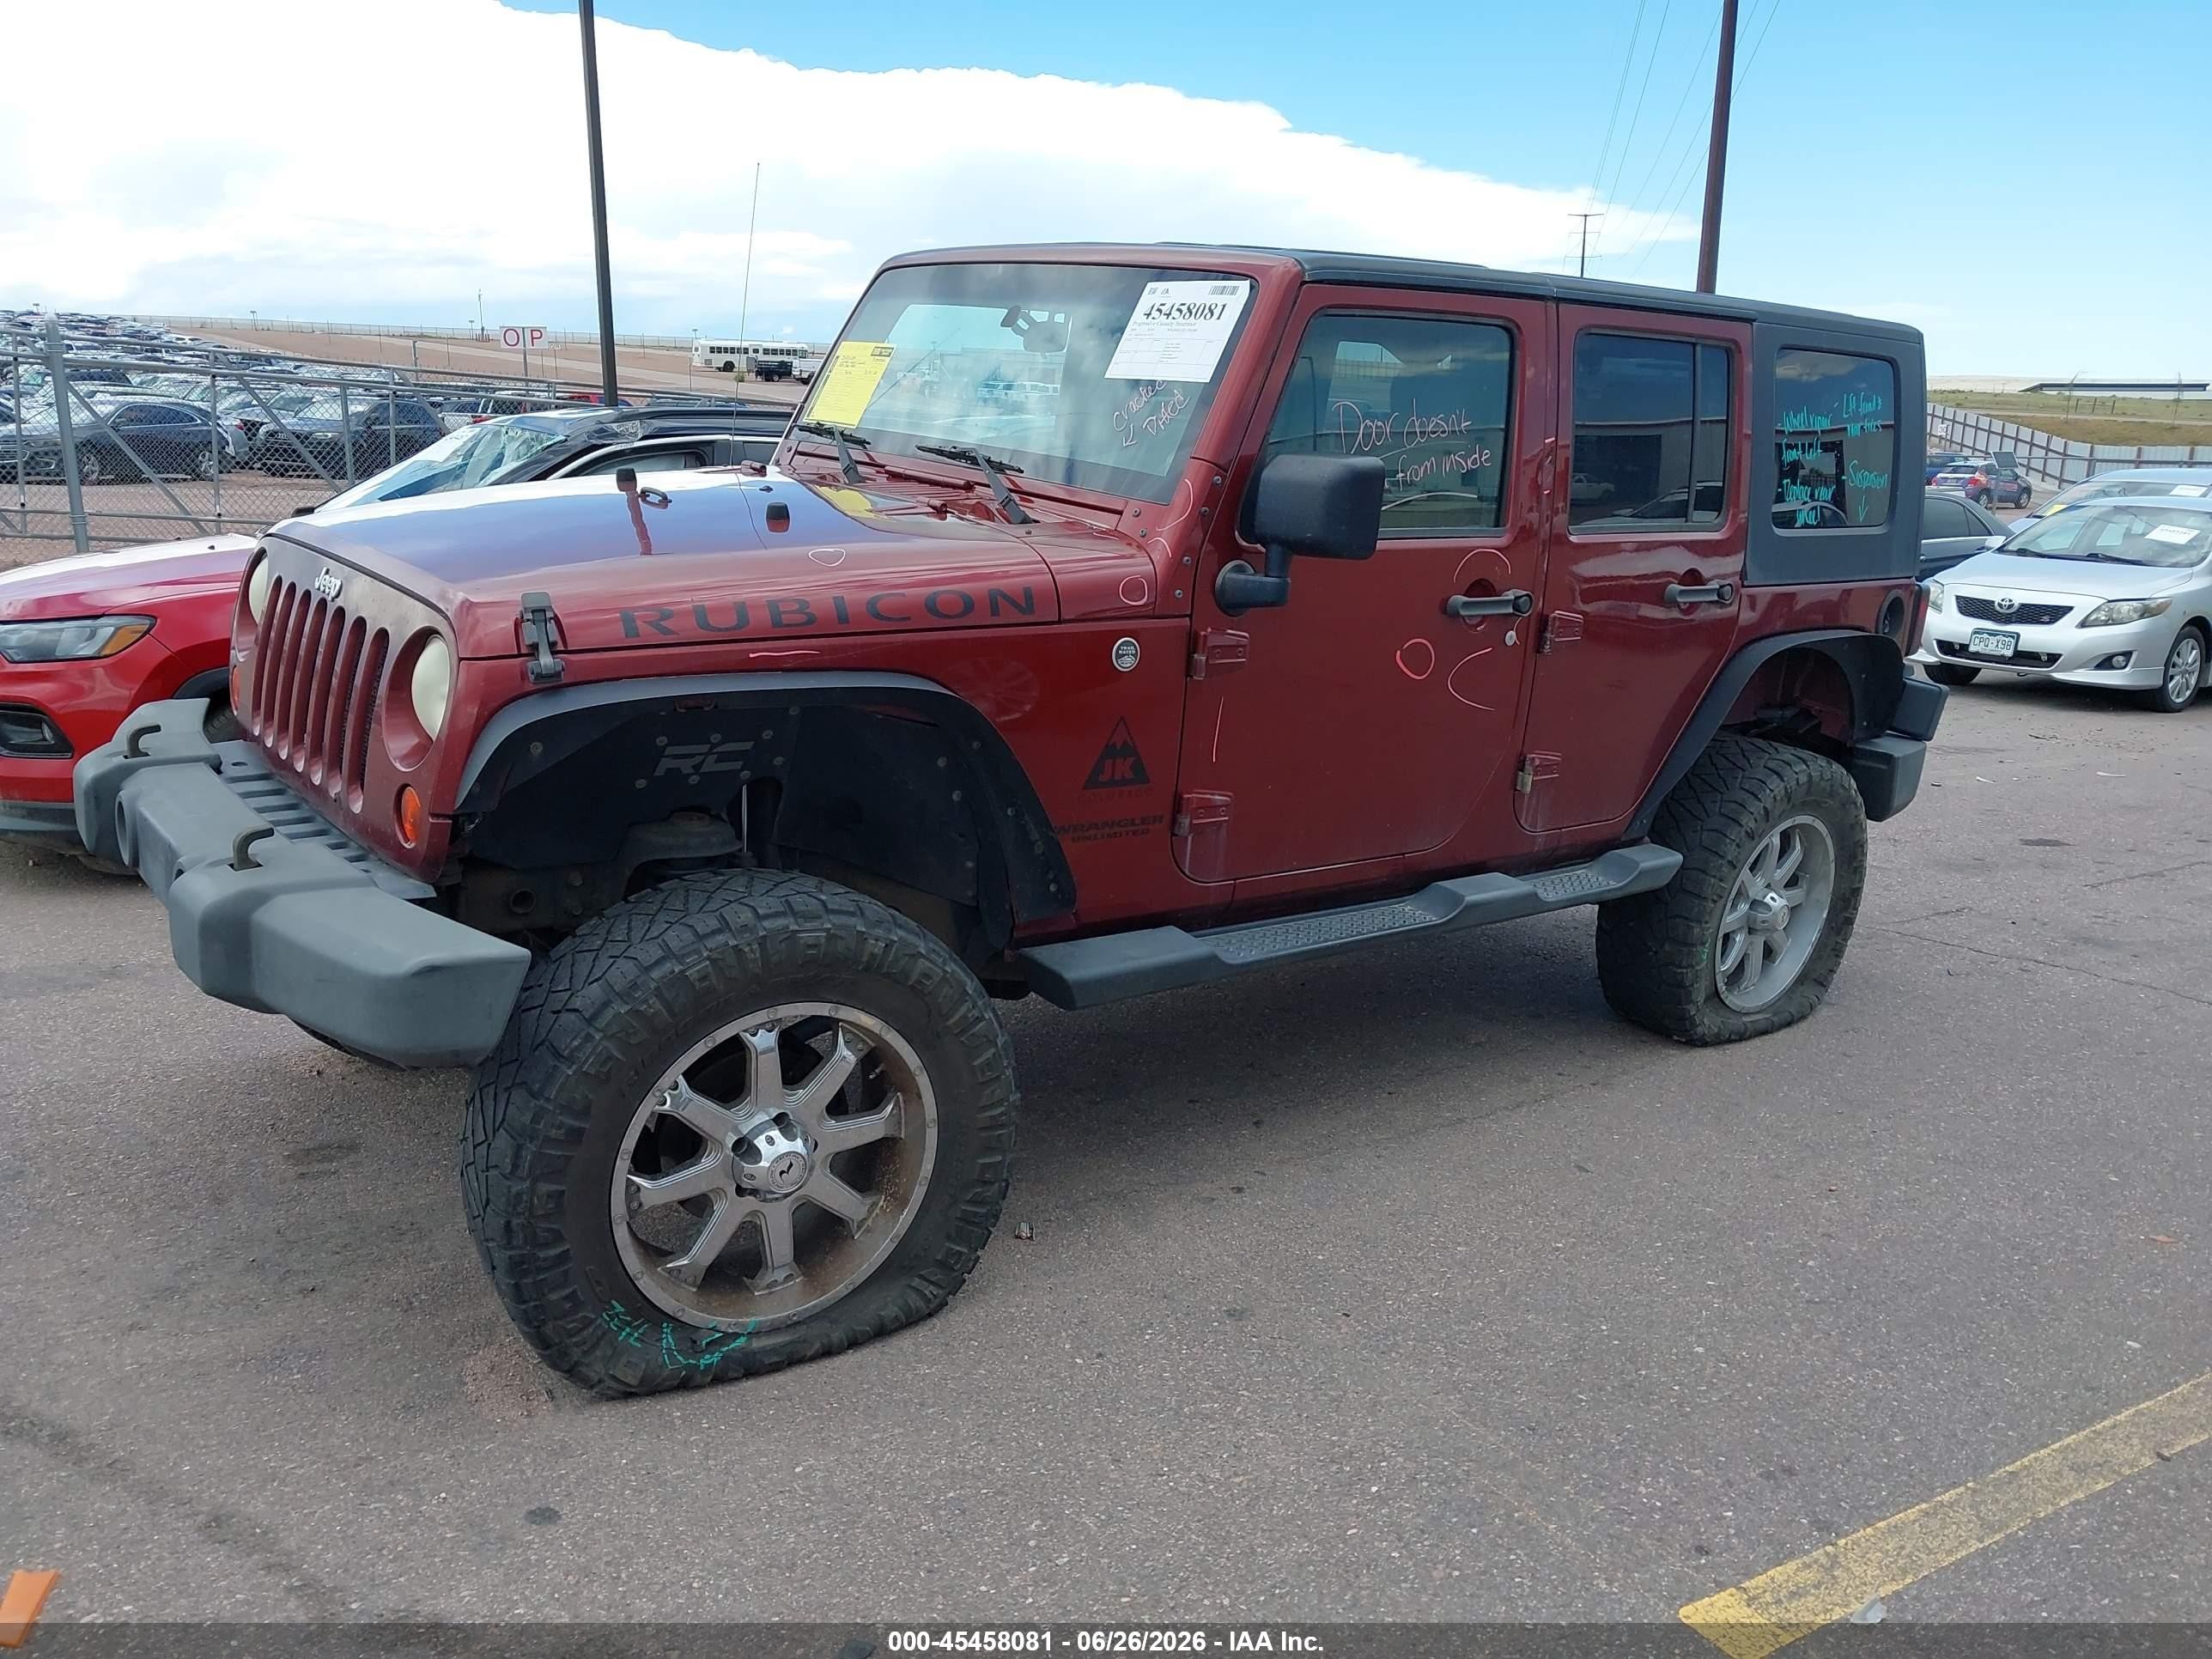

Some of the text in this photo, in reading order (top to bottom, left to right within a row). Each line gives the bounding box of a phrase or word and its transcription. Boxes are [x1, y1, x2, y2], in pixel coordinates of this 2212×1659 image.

[1143, 302, 1227, 320] 45458081
[503, 328, 520, 347] O
[530, 329, 543, 347] P
[1332, 398, 1472, 453] Door doesn't
[1395, 444, 1492, 492] from inside
[314, 567, 343, 602] Jeep
[619, 586, 1036, 638] RUBICON
[1099, 757, 1137, 782] JK
[1054, 814, 1164, 836] WRANGLER
[1071, 829, 1150, 844] UNLIMITED
